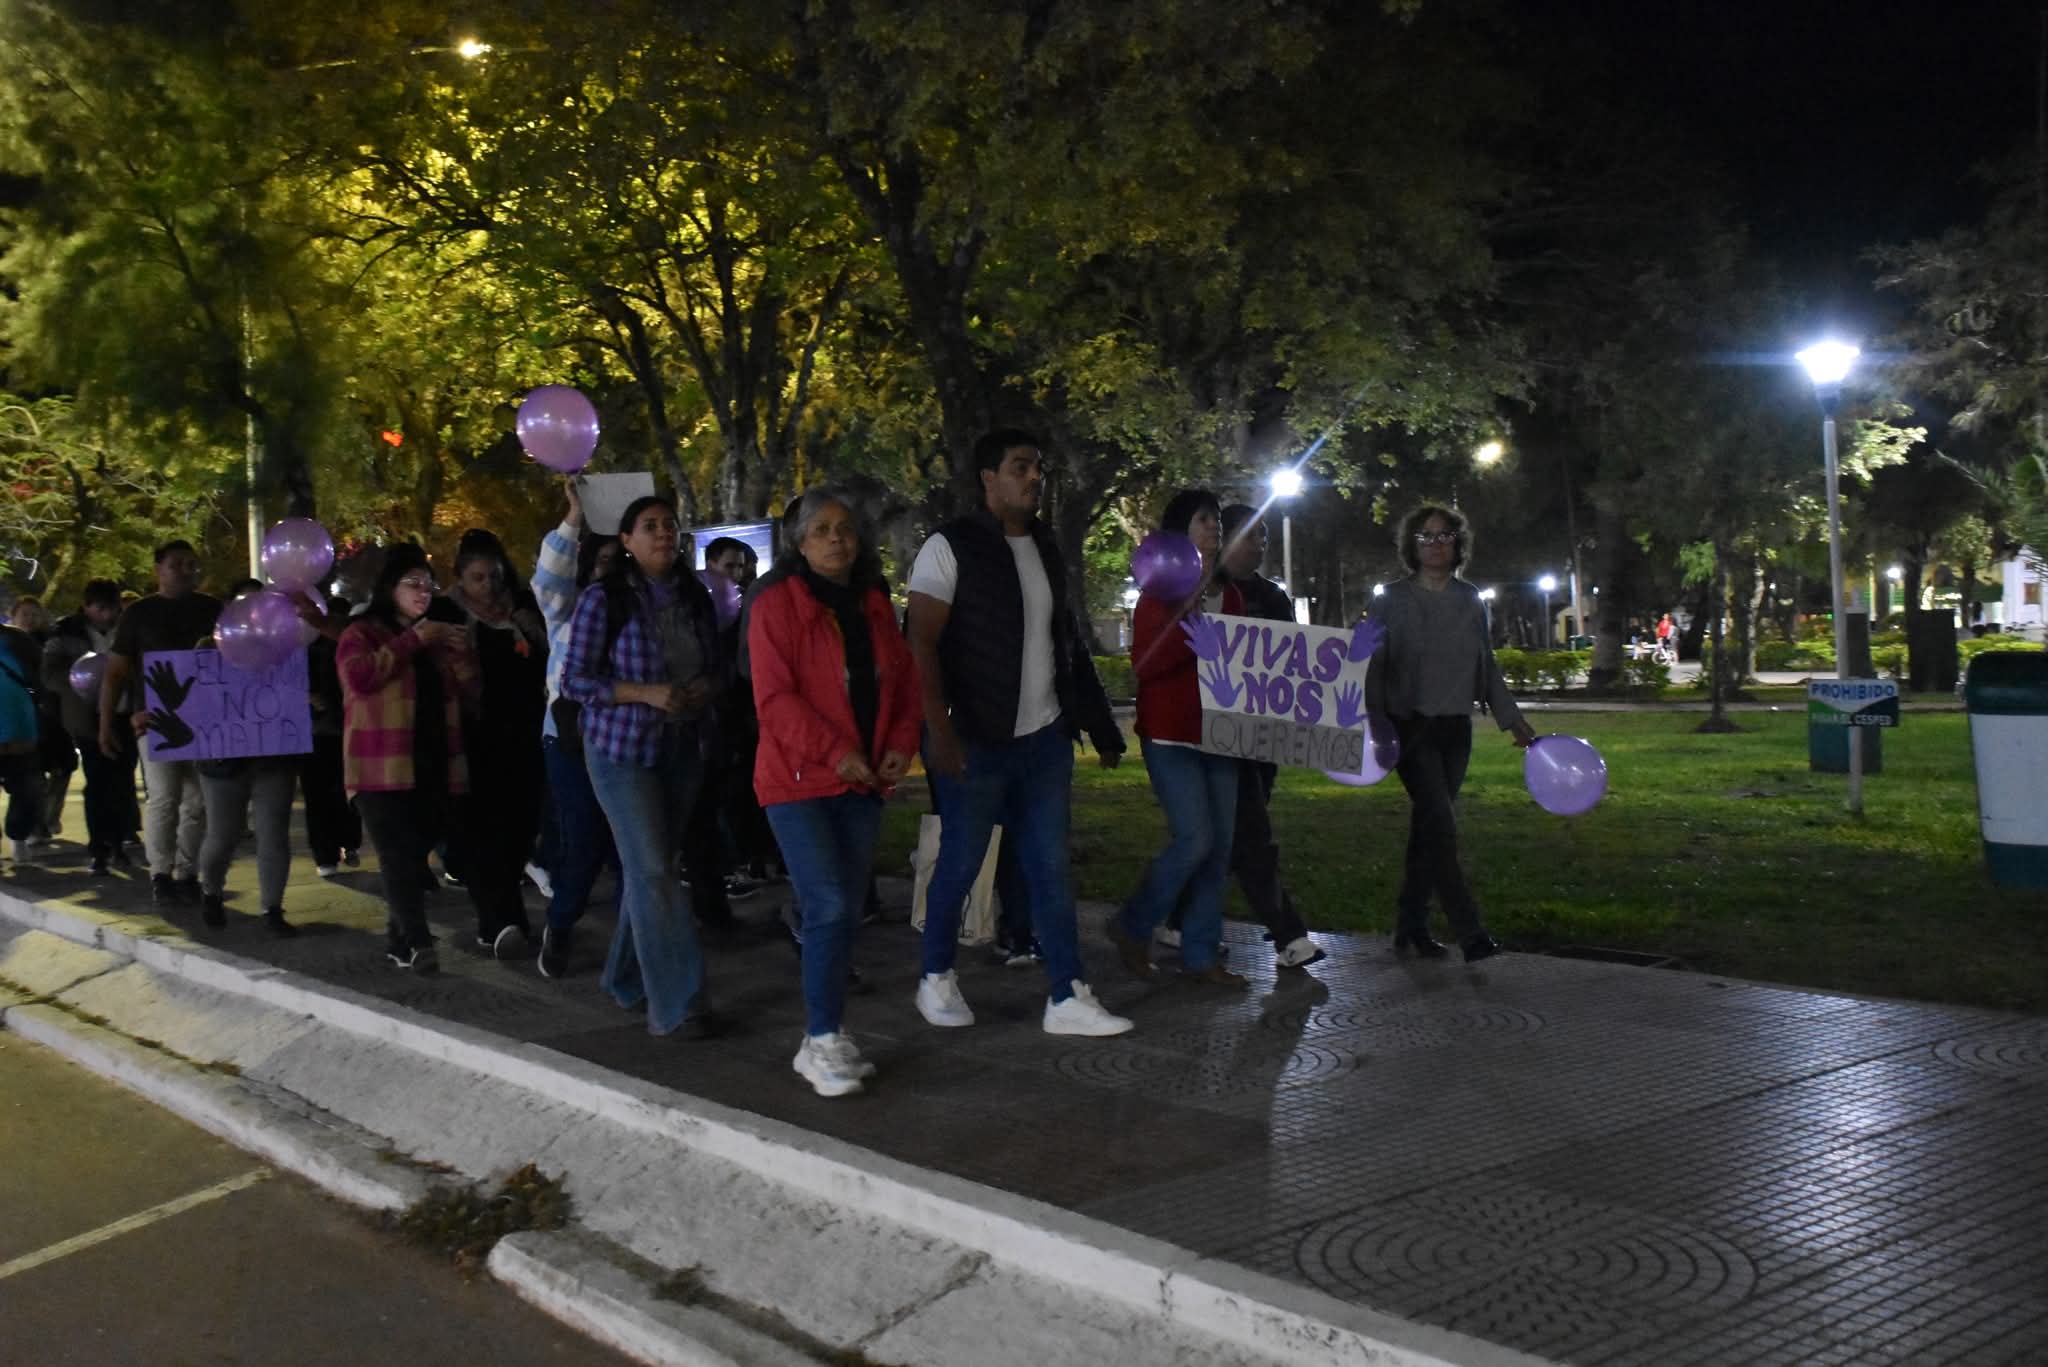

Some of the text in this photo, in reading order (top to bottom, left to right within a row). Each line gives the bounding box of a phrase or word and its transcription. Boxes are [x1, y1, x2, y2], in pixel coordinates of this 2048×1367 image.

[195, 651, 230, 686] EL
[1214, 619, 1349, 683] VIVAS
[222, 684, 282, 721] NO
[1241, 671, 1323, 726] NOS
[1811, 683, 1895, 700] PROHIBIDO
[197, 717, 302, 759] MATA
[1211, 713, 1363, 772] QUEREMOS
